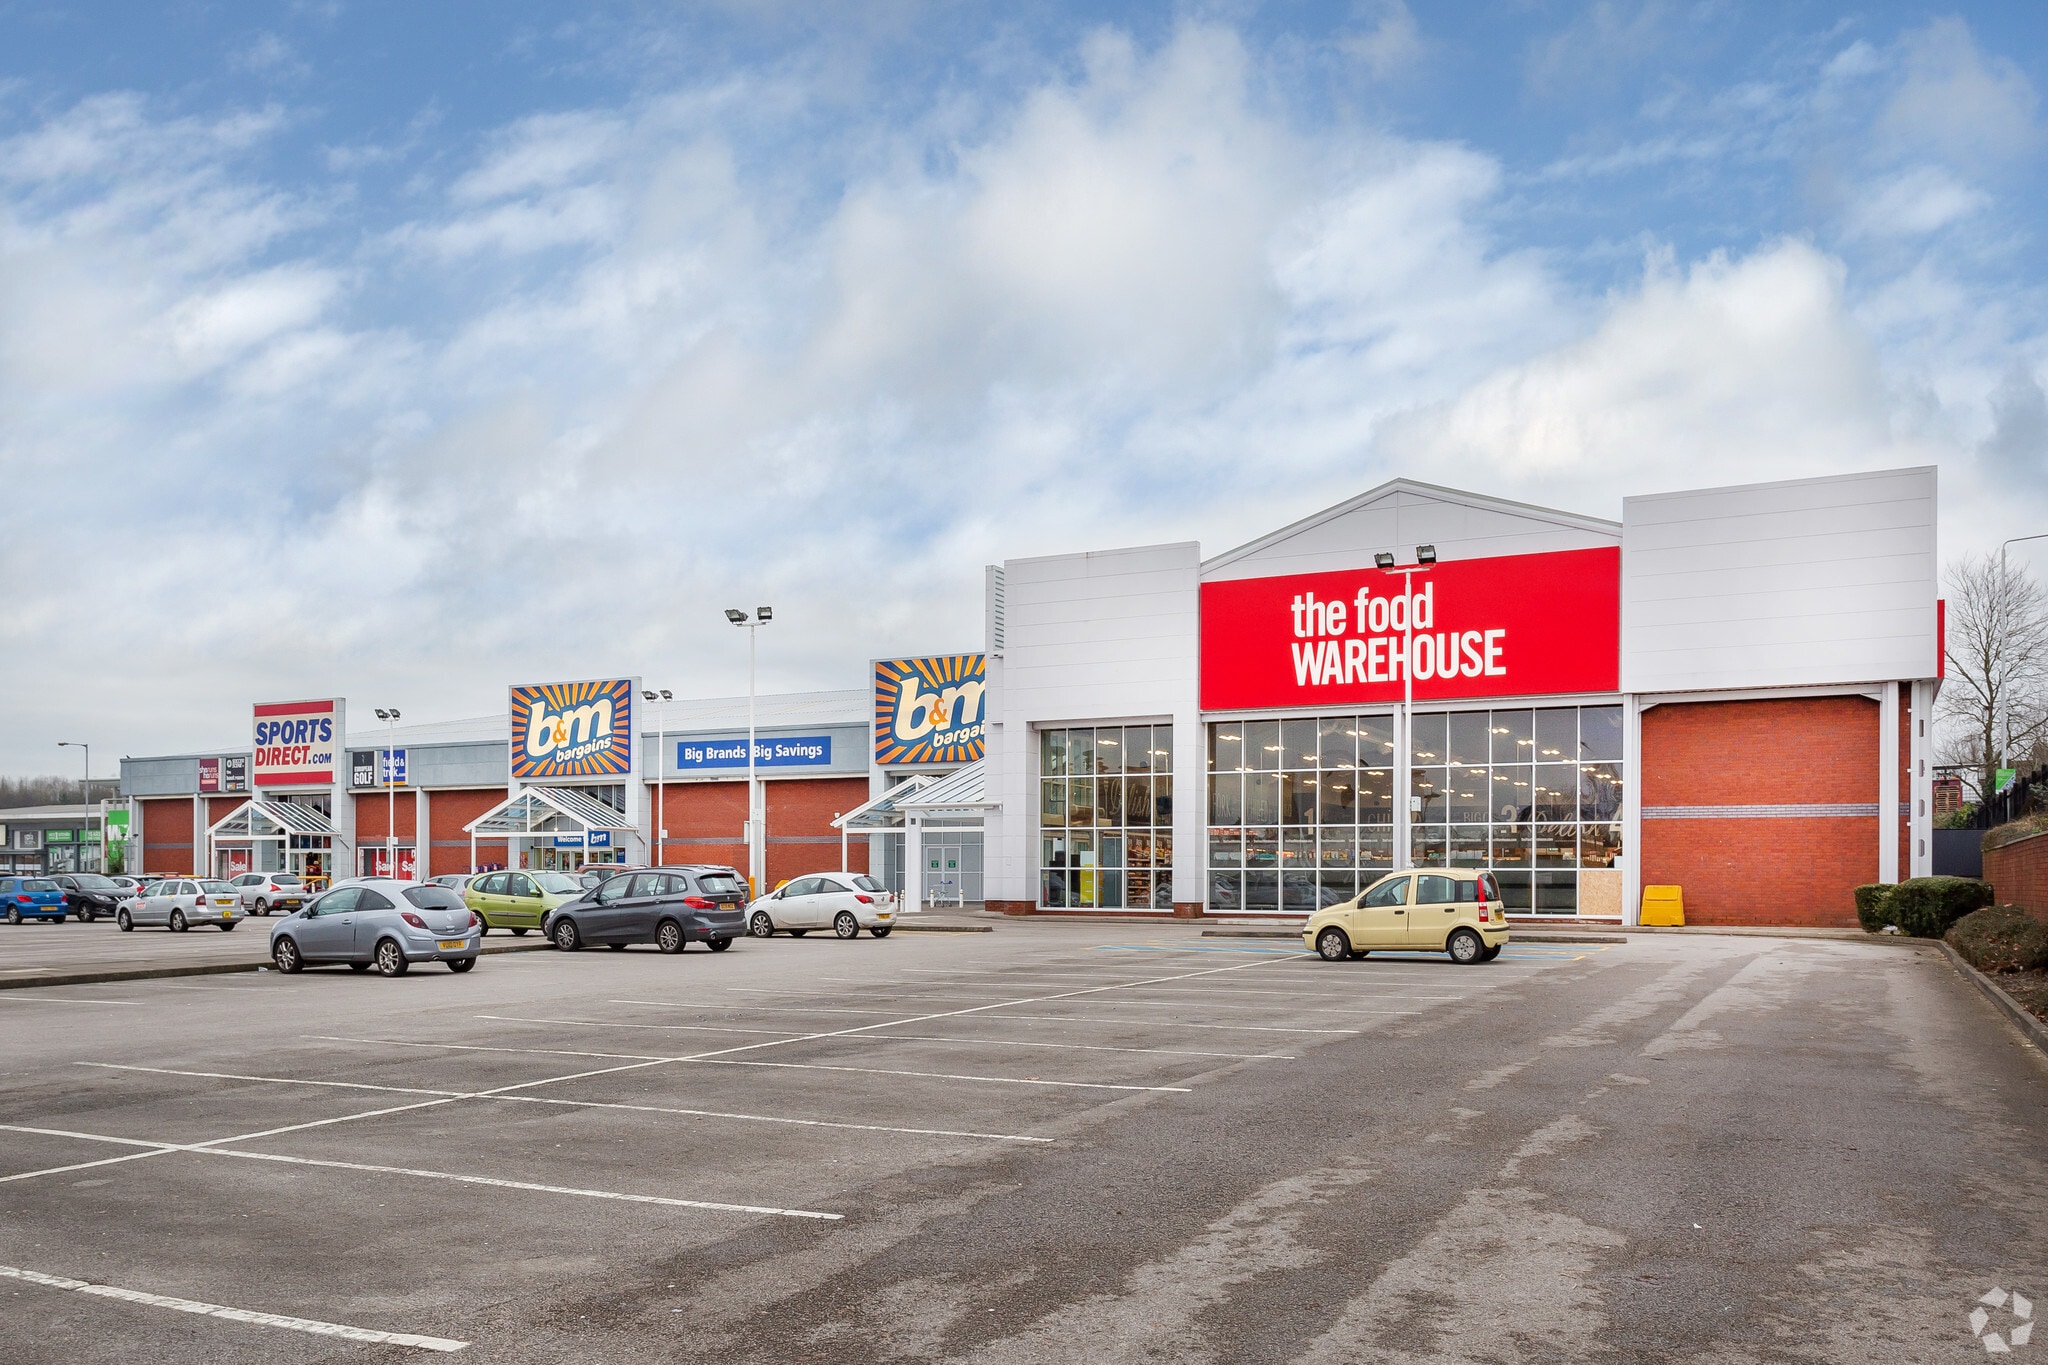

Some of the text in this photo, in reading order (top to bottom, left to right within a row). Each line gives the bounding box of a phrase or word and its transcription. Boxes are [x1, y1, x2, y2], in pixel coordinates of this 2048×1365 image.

[1291, 581, 1434, 638] the food
[1291, 628, 1507, 687] WAREHOUSE
[255, 718, 333, 746] SPORTS
[527, 699, 613, 757] b&m
[933, 720, 985, 748] bargai
[556, 737, 612, 763] bargains
[684, 743, 823, 763] Big Brands Big Savings
[354, 771, 373, 785] GOLF
[557, 834, 583, 843] Welcome
[230, 860, 247, 871] Sale
